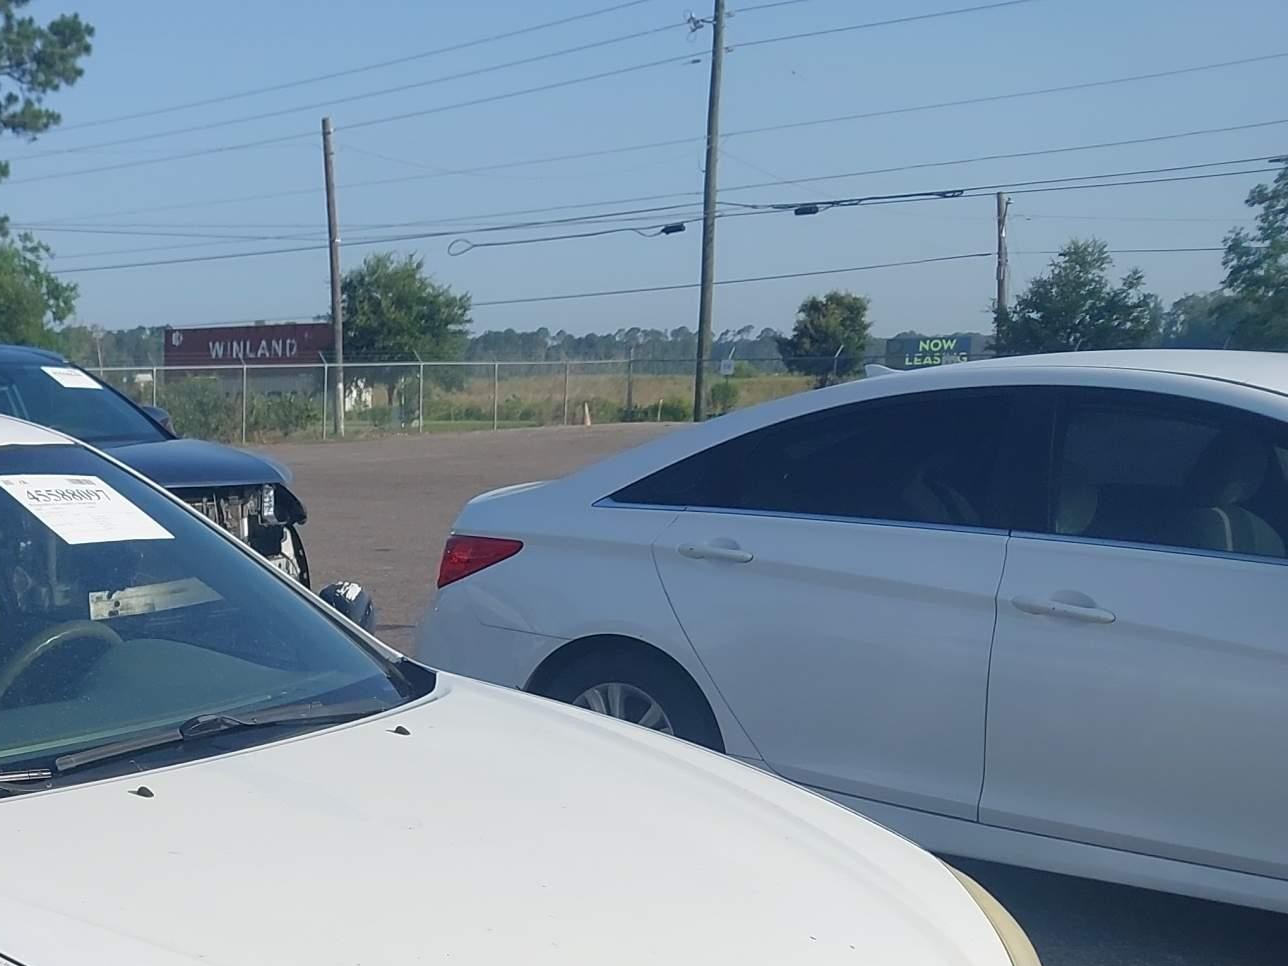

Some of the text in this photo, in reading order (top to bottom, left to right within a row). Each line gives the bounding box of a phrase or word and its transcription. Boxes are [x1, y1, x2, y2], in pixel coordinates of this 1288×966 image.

[208, 338, 298, 359] WINLAND
[919, 338, 957, 351] NOW
[905, 352, 968, 366] LEASG
[26, 488, 112, 502] 45588097
